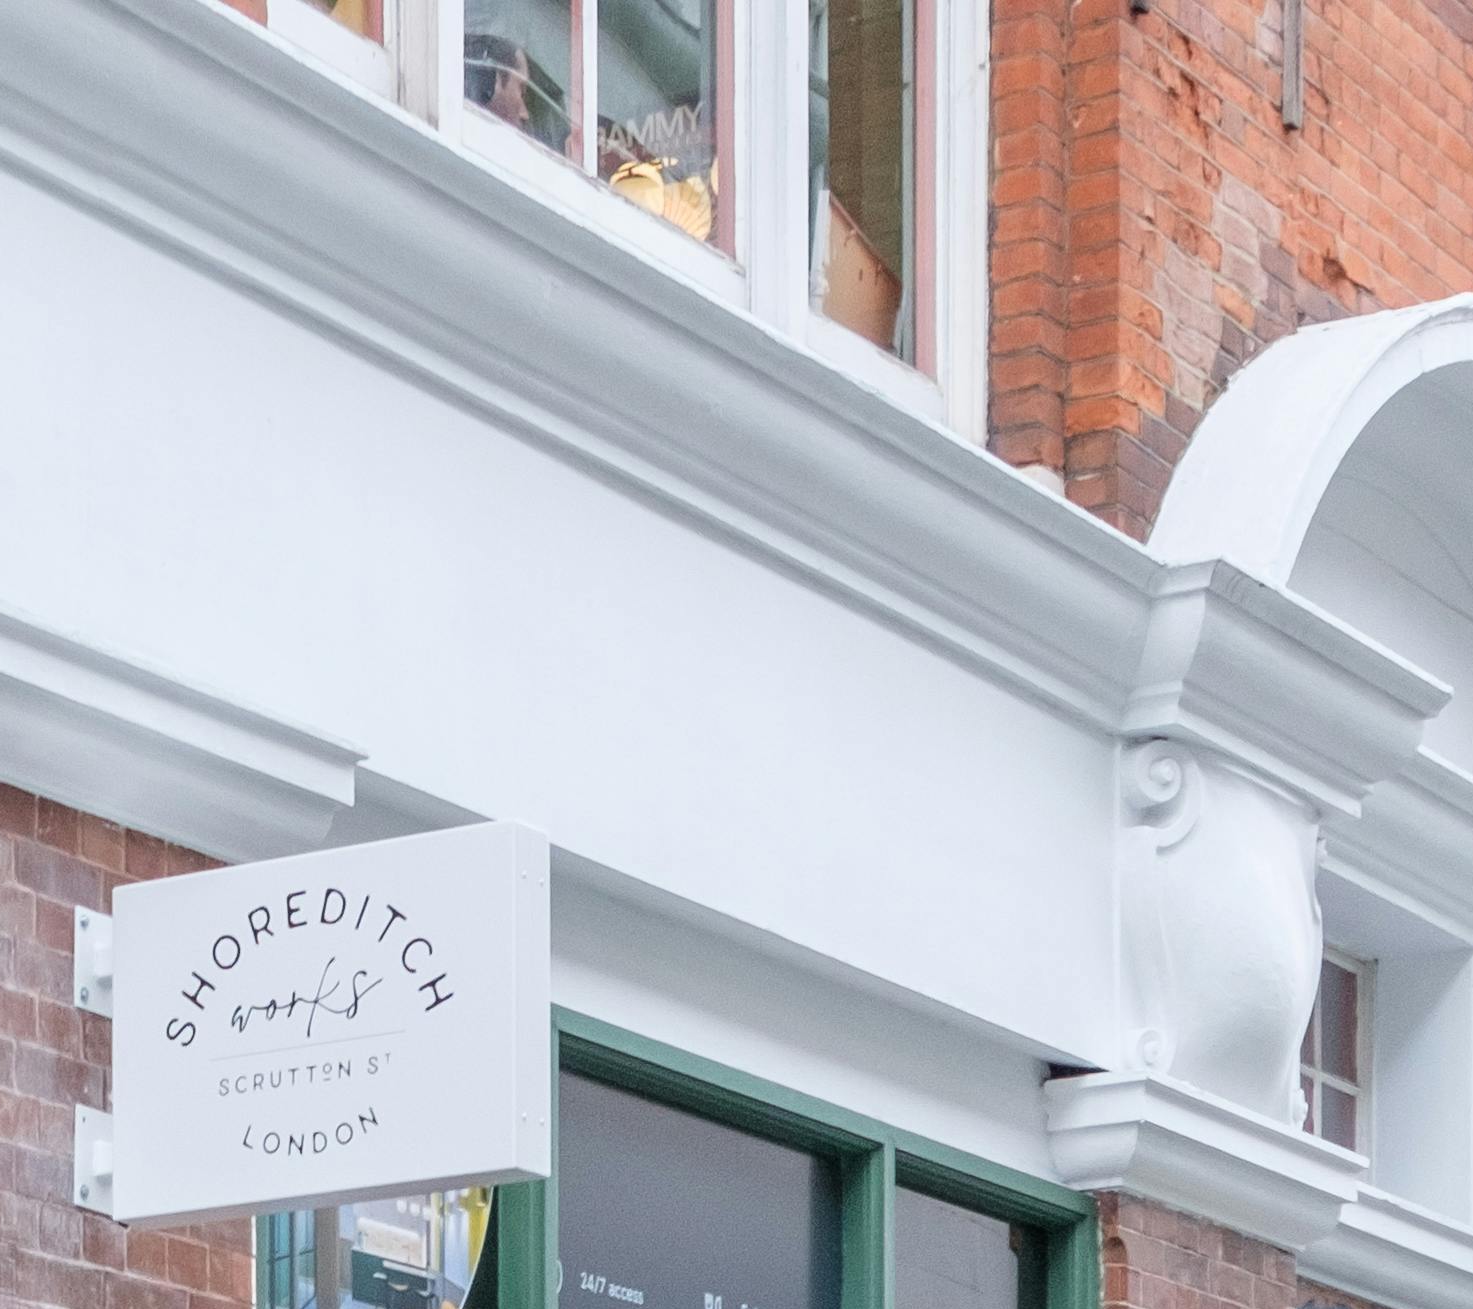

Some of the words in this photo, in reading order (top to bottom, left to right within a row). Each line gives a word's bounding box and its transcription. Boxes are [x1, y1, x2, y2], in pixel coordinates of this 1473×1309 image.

[166, 887, 455, 1047] SHOREDITCH
[230, 956, 383, 1038] works
[218, 1060, 352, 1096] SCRUTTON
[242, 1107, 379, 1156] LONDON
[580, 1272, 607, 1294] 24/7
[608, 1283, 644, 1305] access
